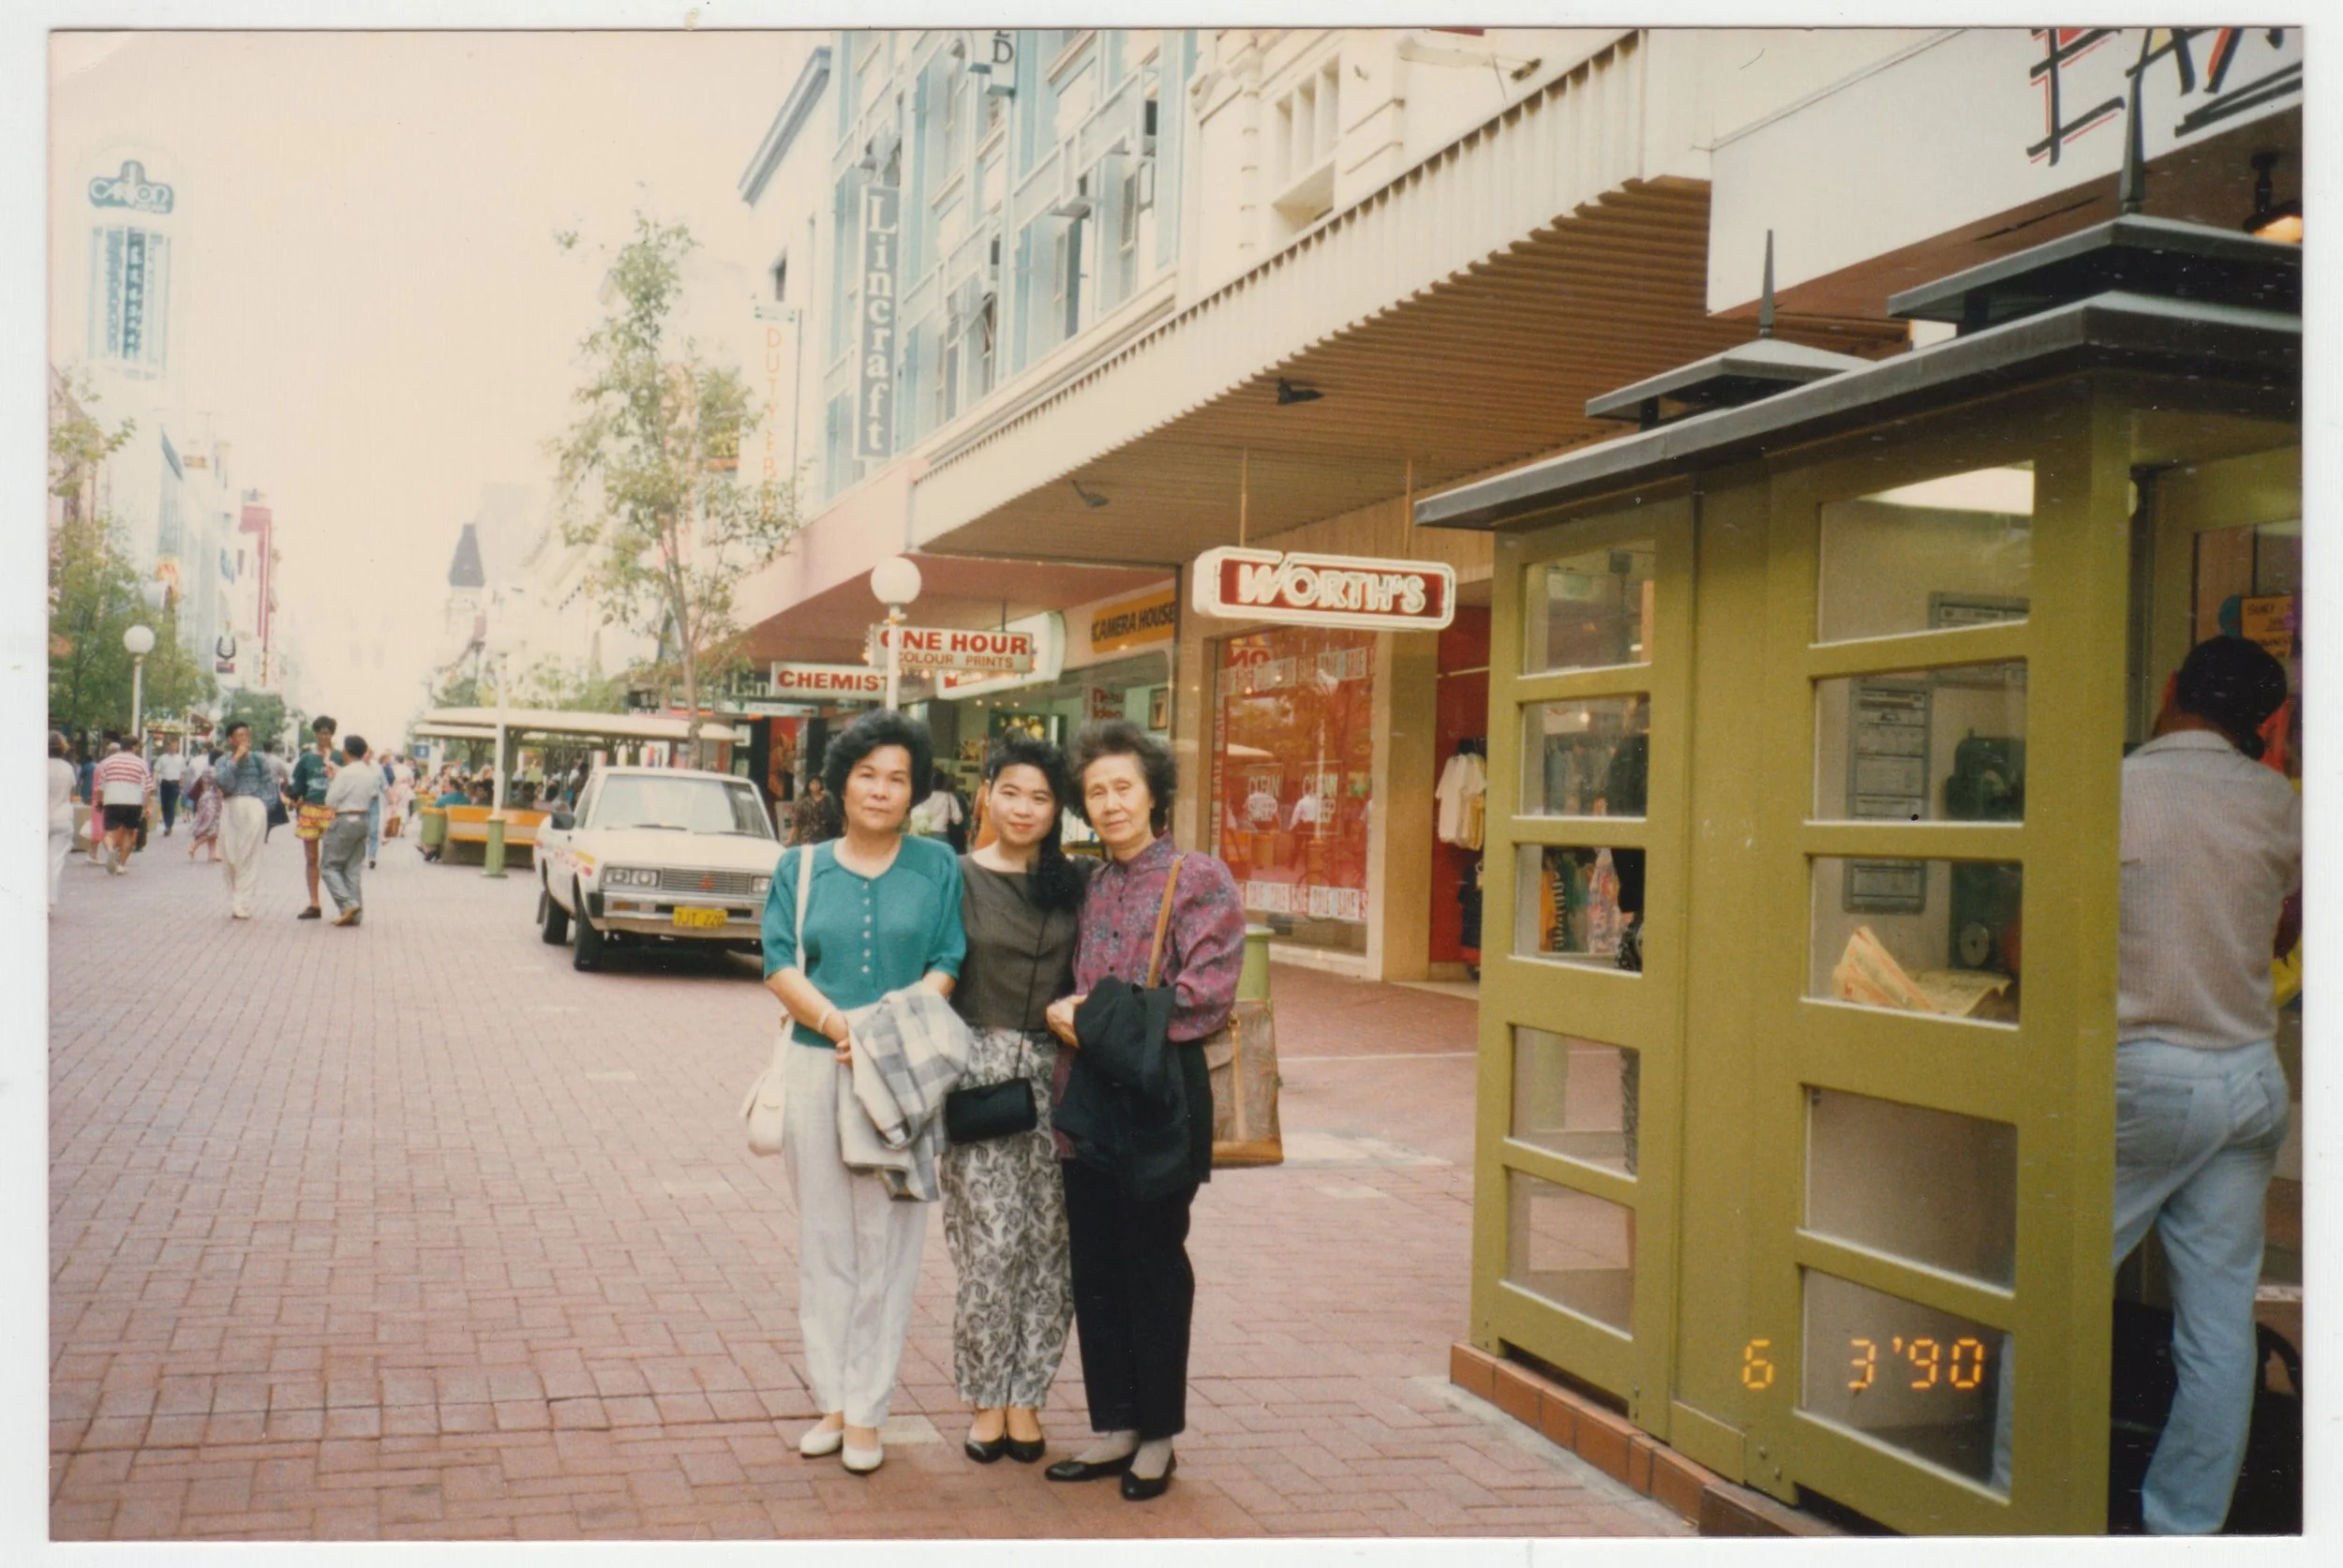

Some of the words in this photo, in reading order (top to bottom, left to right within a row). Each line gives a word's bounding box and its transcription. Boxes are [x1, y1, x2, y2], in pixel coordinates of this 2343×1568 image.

[866, 195, 897, 450] Lincraft
[764, 327, 783, 419] DUTY
[1237, 560, 1426, 614] WORTH'S
[1139, 601, 1176, 631] HOUSE
[899, 651, 954, 665] COLOUR
[965, 654, 1013, 668] PRINTS
[950, 633, 1027, 654] HOUR
